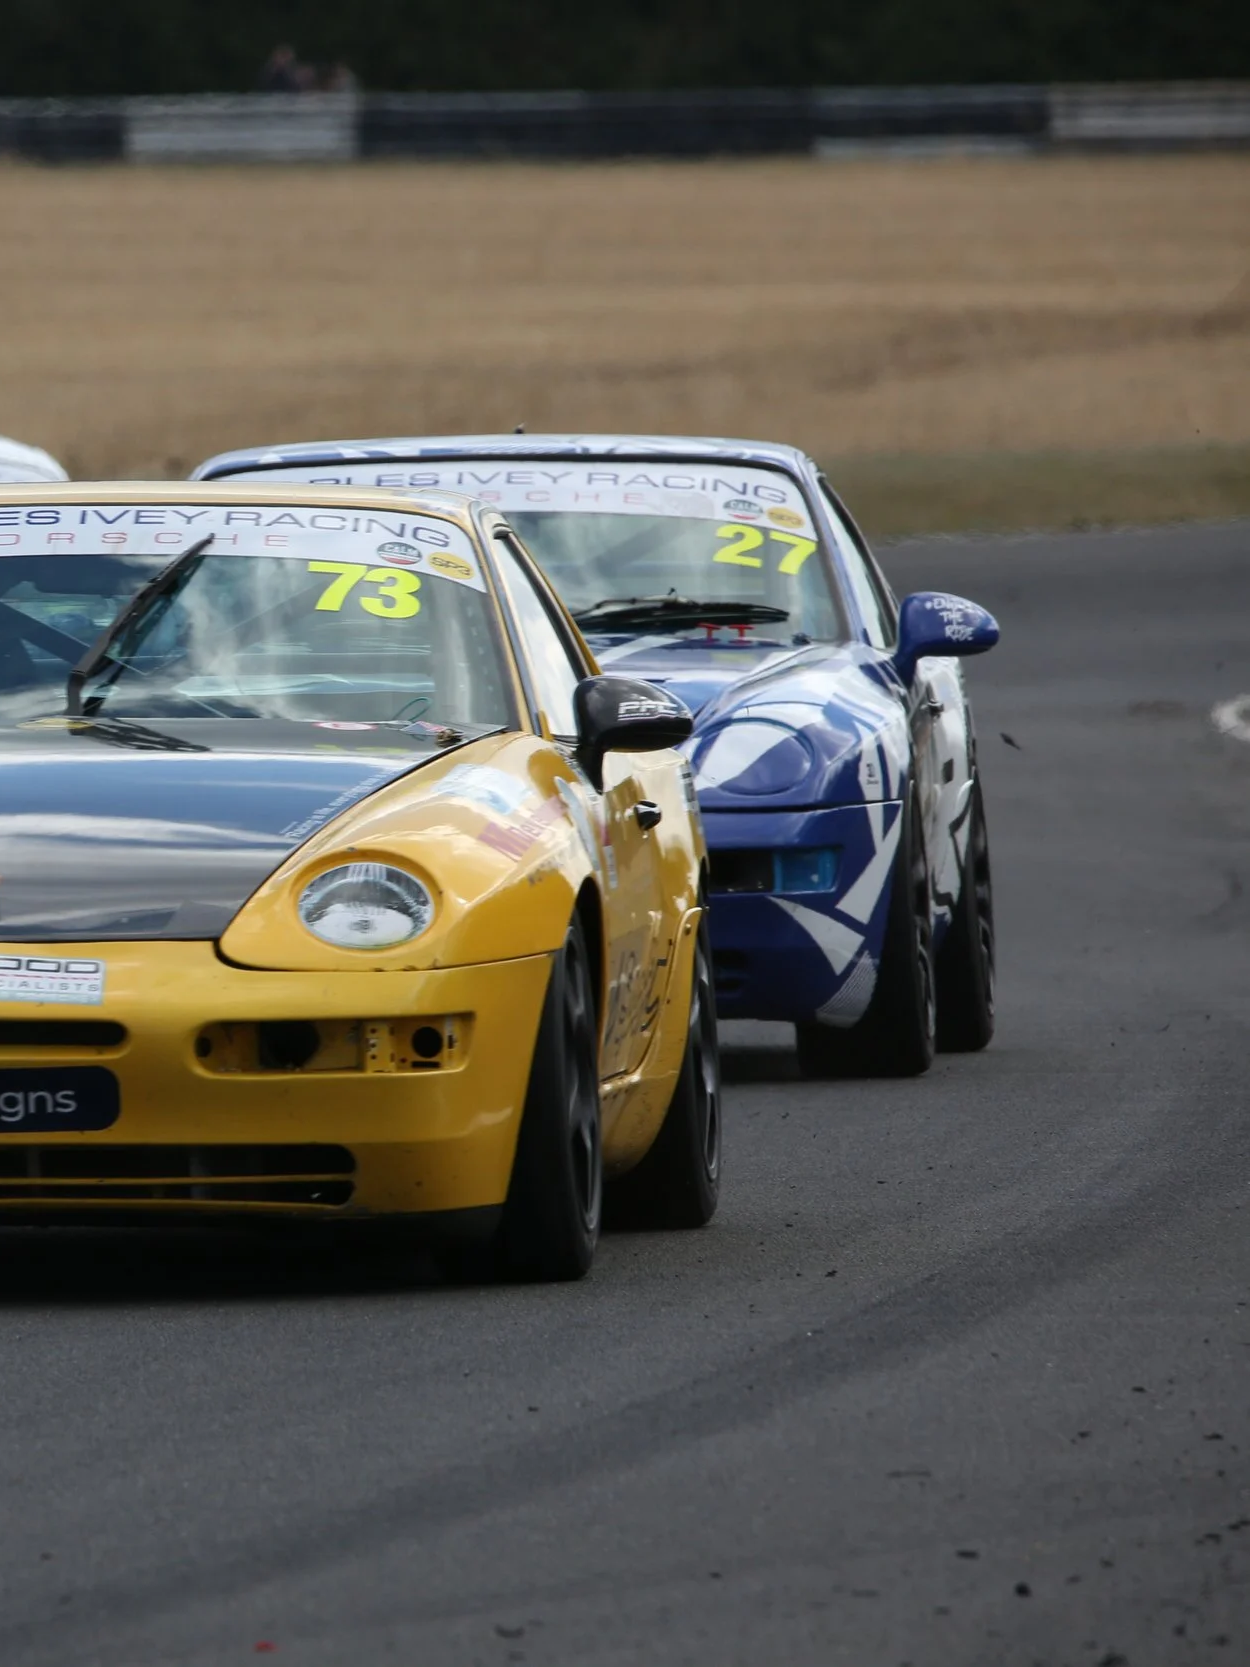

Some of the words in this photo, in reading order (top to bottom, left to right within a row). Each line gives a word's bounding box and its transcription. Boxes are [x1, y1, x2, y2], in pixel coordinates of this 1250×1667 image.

[457, 471, 573, 485] IVEY
[586, 471, 788, 504] RACING
[79, 509, 209, 525] IVEY
[225, 510, 450, 548] RACING
[712, 523, 818, 576] 27
[307, 561, 422, 619] 73
